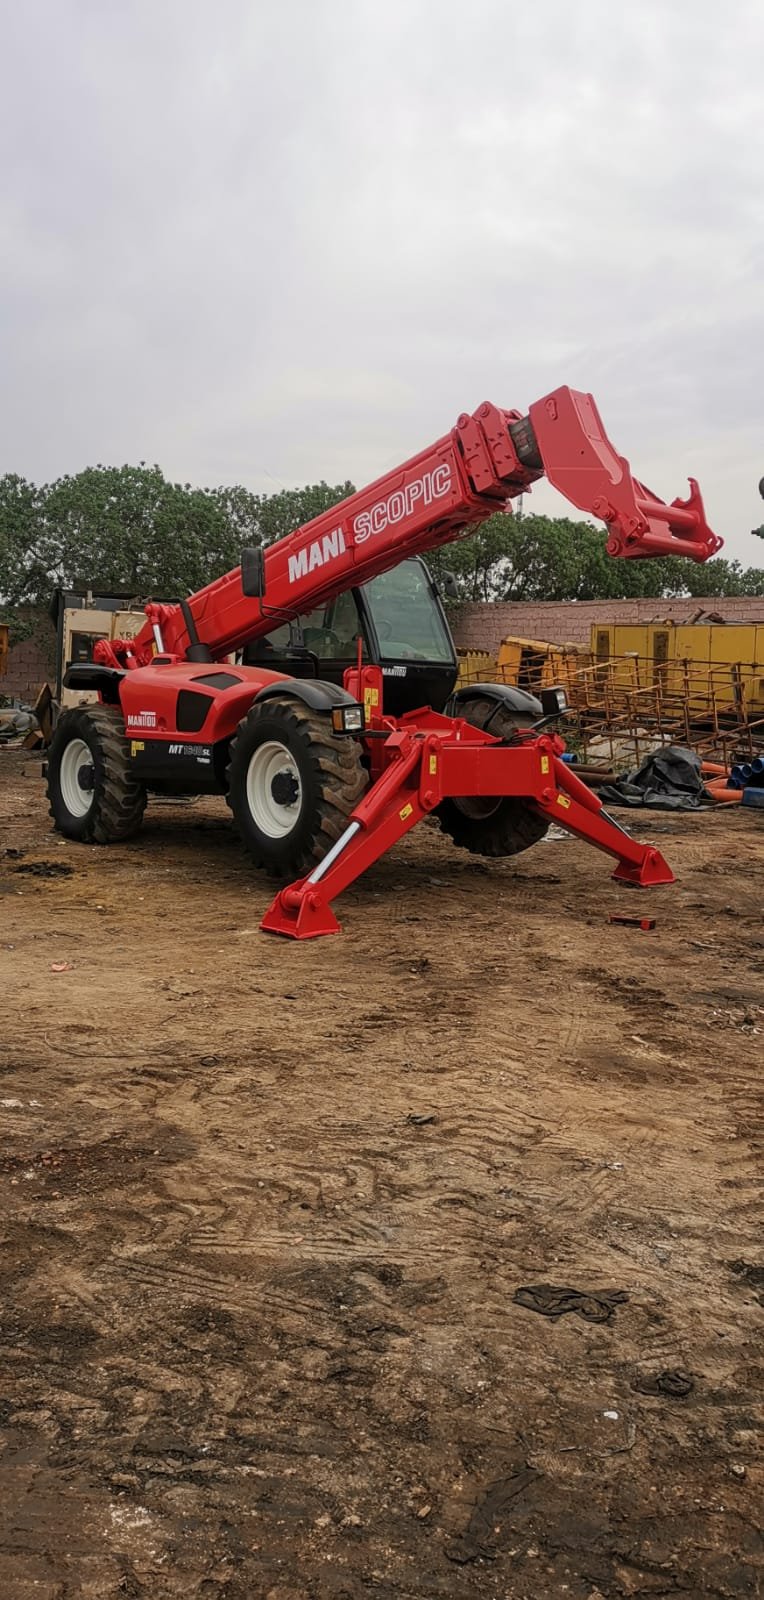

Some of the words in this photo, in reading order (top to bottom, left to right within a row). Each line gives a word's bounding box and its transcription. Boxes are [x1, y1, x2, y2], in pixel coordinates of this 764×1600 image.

[288, 528, 346, 583] MANI
[353, 463, 451, 544] SCOPIC
[127, 711, 156, 727] MANITOU
